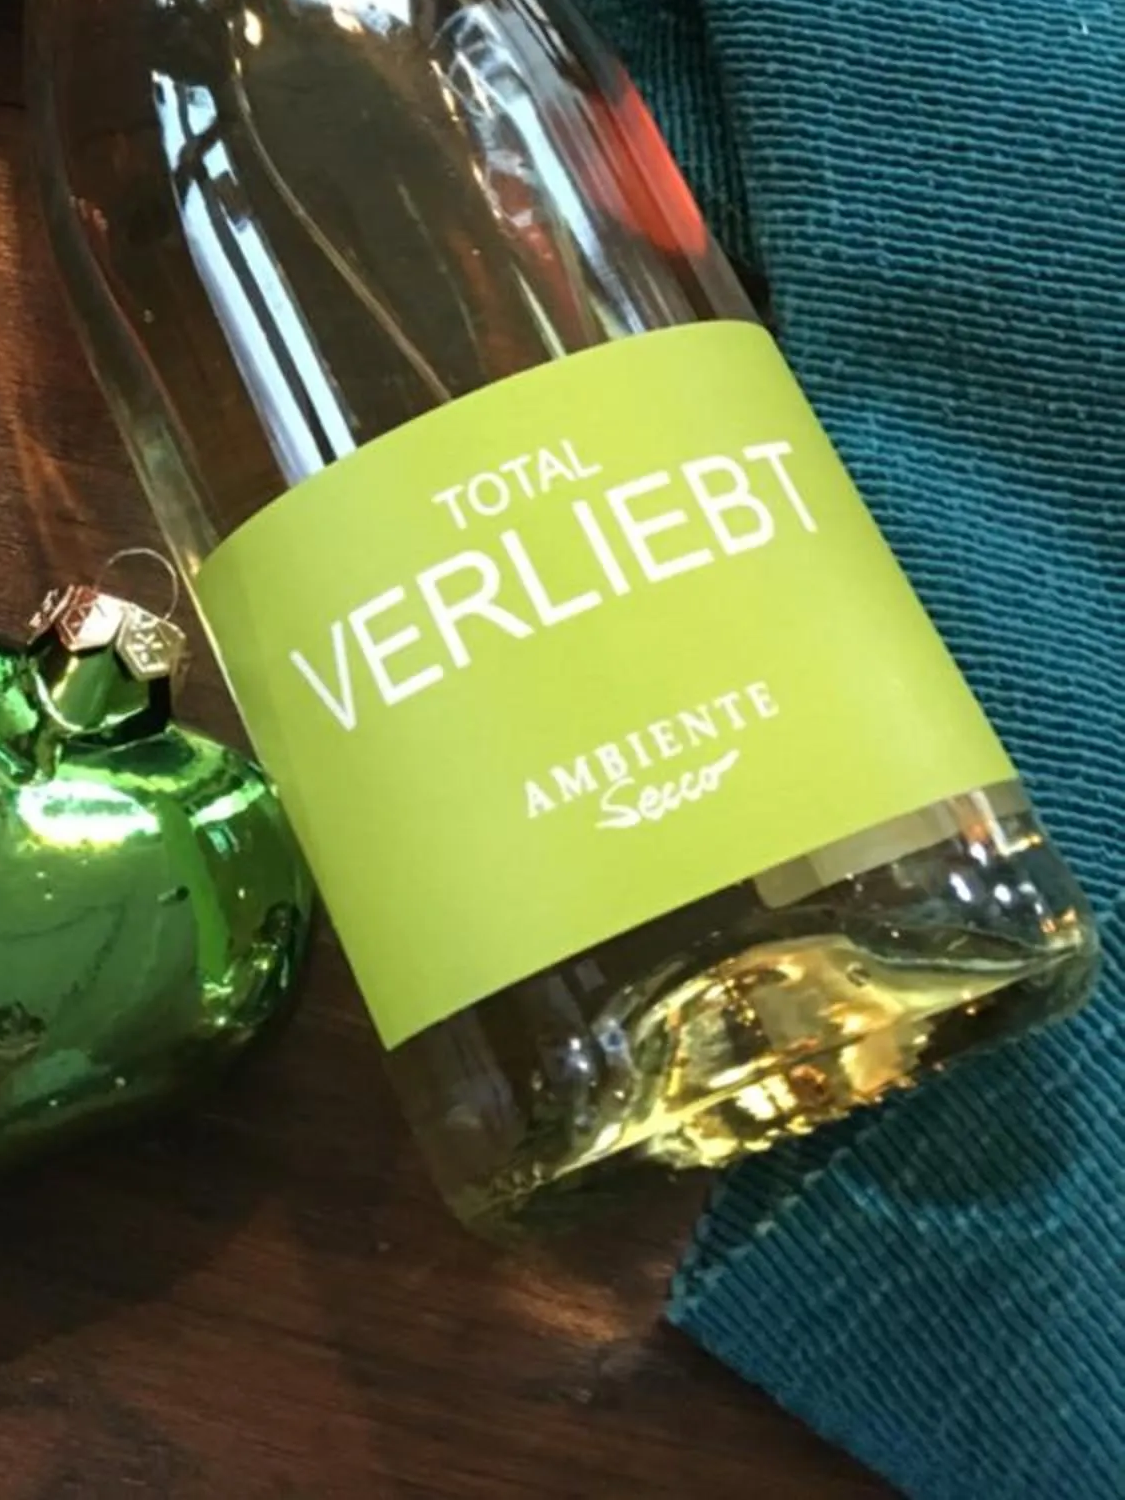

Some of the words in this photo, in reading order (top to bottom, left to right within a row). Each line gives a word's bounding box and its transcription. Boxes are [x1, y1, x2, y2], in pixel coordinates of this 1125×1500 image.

[433, 439, 603, 530] TOTAL
[290, 441, 818, 732] VERLIEBT
[523, 681, 780, 819] AMBIENTE
[596, 750, 741, 831] Secco
